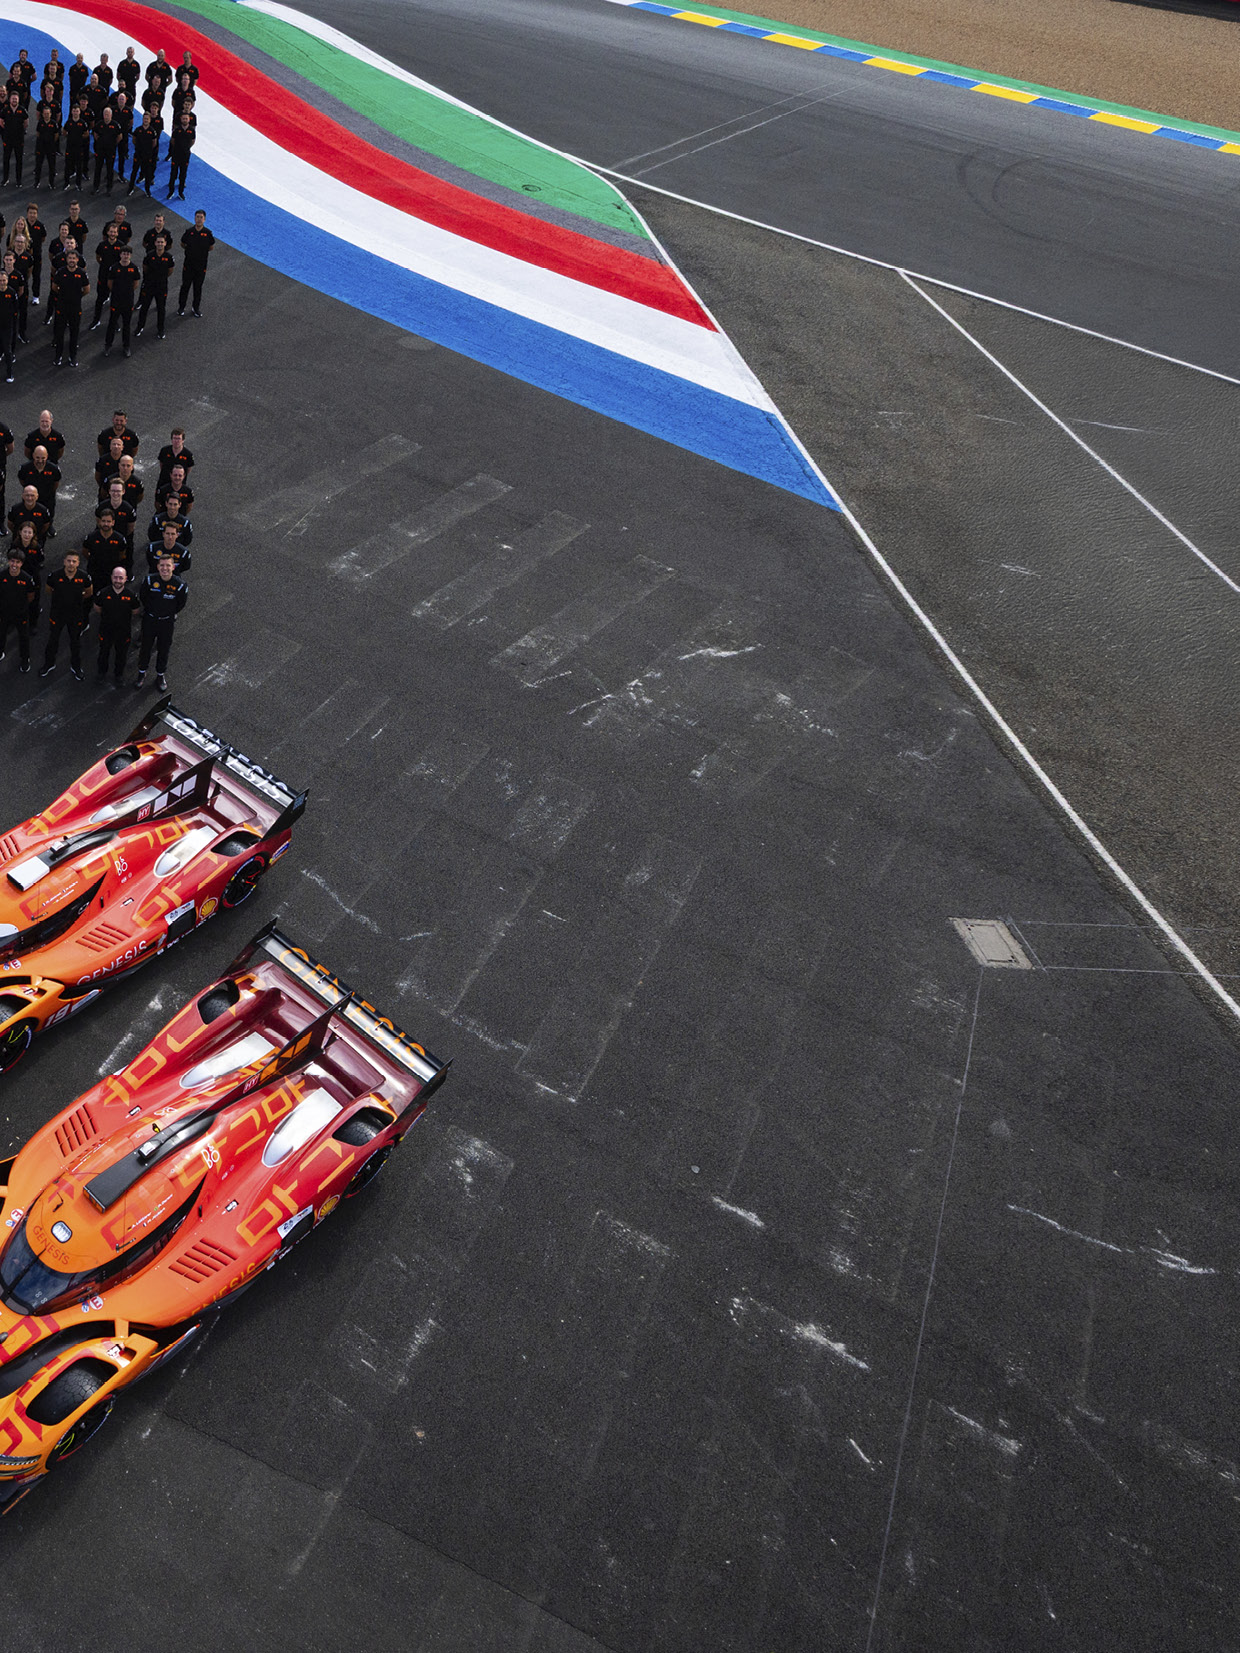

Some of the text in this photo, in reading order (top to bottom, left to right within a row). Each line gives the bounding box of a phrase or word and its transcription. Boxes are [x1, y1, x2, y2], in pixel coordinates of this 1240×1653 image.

[173, 718, 288, 799] GENESIS
[76, 940, 148, 986] GENESIS
[44, 1003, 71, 1028] 19
[279, 947, 426, 1068] GENESIS
[32, 1225, 71, 1265] GENESIS
